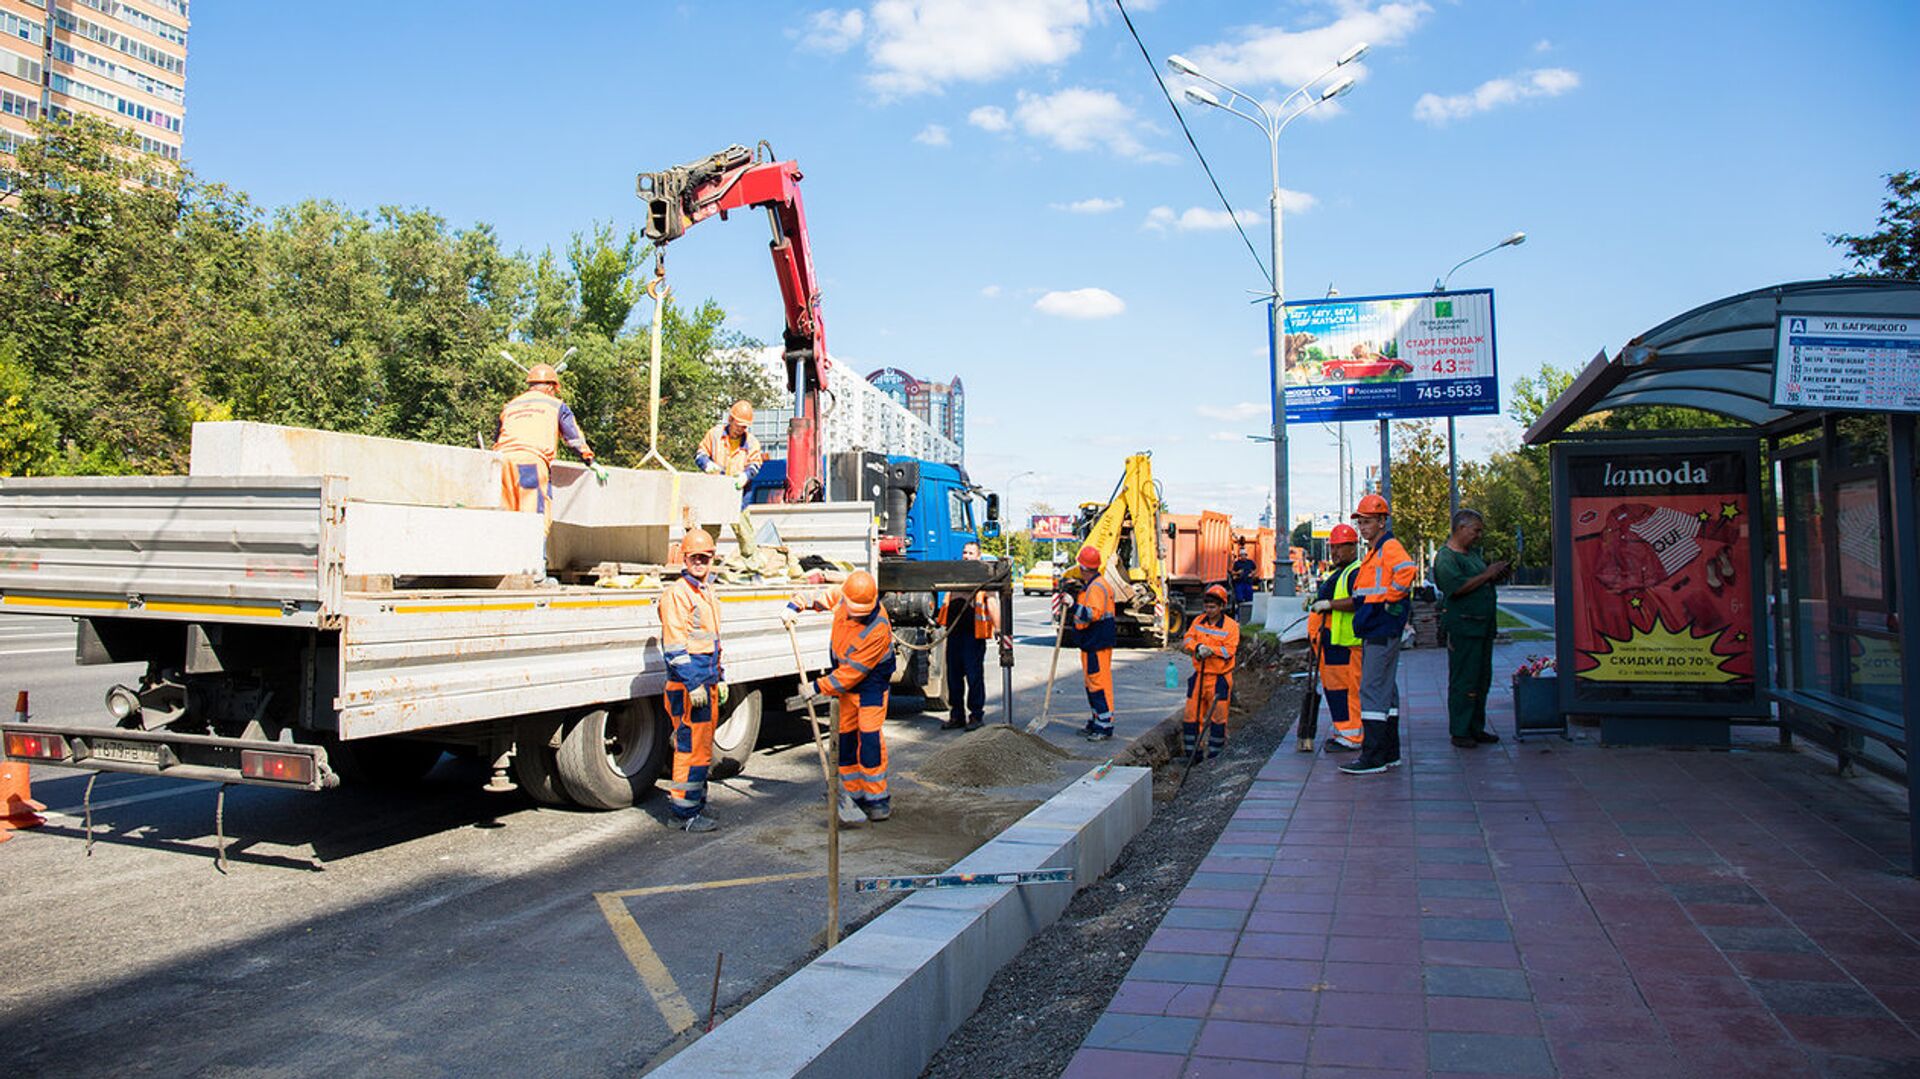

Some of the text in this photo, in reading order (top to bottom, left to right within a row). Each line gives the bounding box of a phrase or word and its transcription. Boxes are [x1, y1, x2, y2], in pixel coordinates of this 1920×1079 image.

[1841, 323, 1908, 333] БАГРИЦКОГО
[1406, 336, 1484, 348] СТАРТ ПРОДАЖ
[1416, 385, 1482, 399] 745-5533
[1604, 461, 1709, 486] lamoda
[1610, 656, 1714, 667] СКИДКИ ДО 70%
